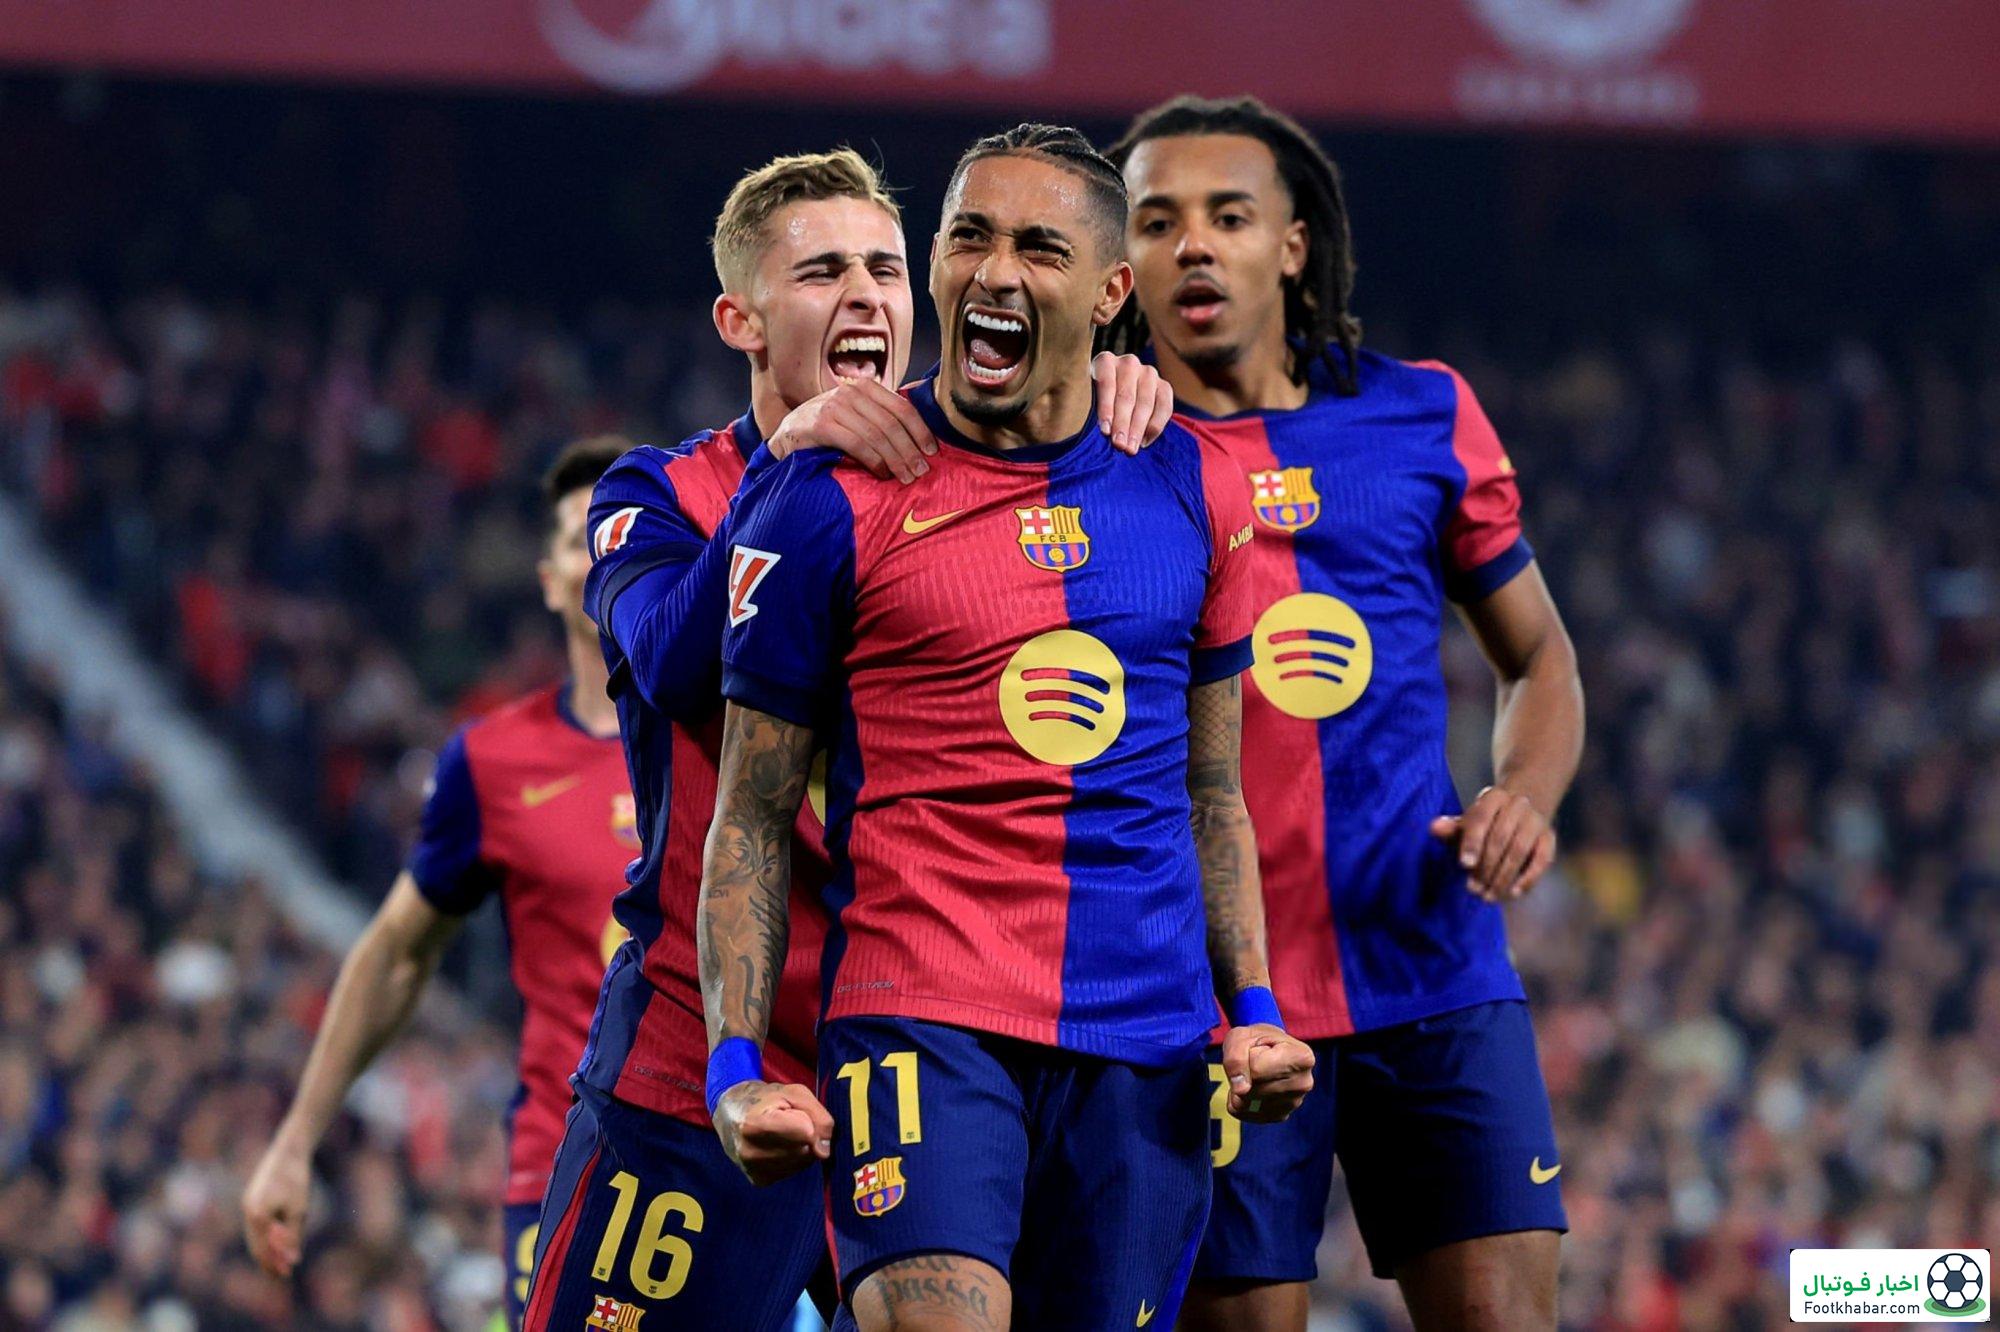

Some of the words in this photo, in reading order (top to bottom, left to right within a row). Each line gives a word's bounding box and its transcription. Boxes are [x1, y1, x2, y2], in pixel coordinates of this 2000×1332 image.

[1040, 534, 1067, 543] FCB
[836, 1051, 921, 1157] 11
[591, 1170, 704, 1300] 16
